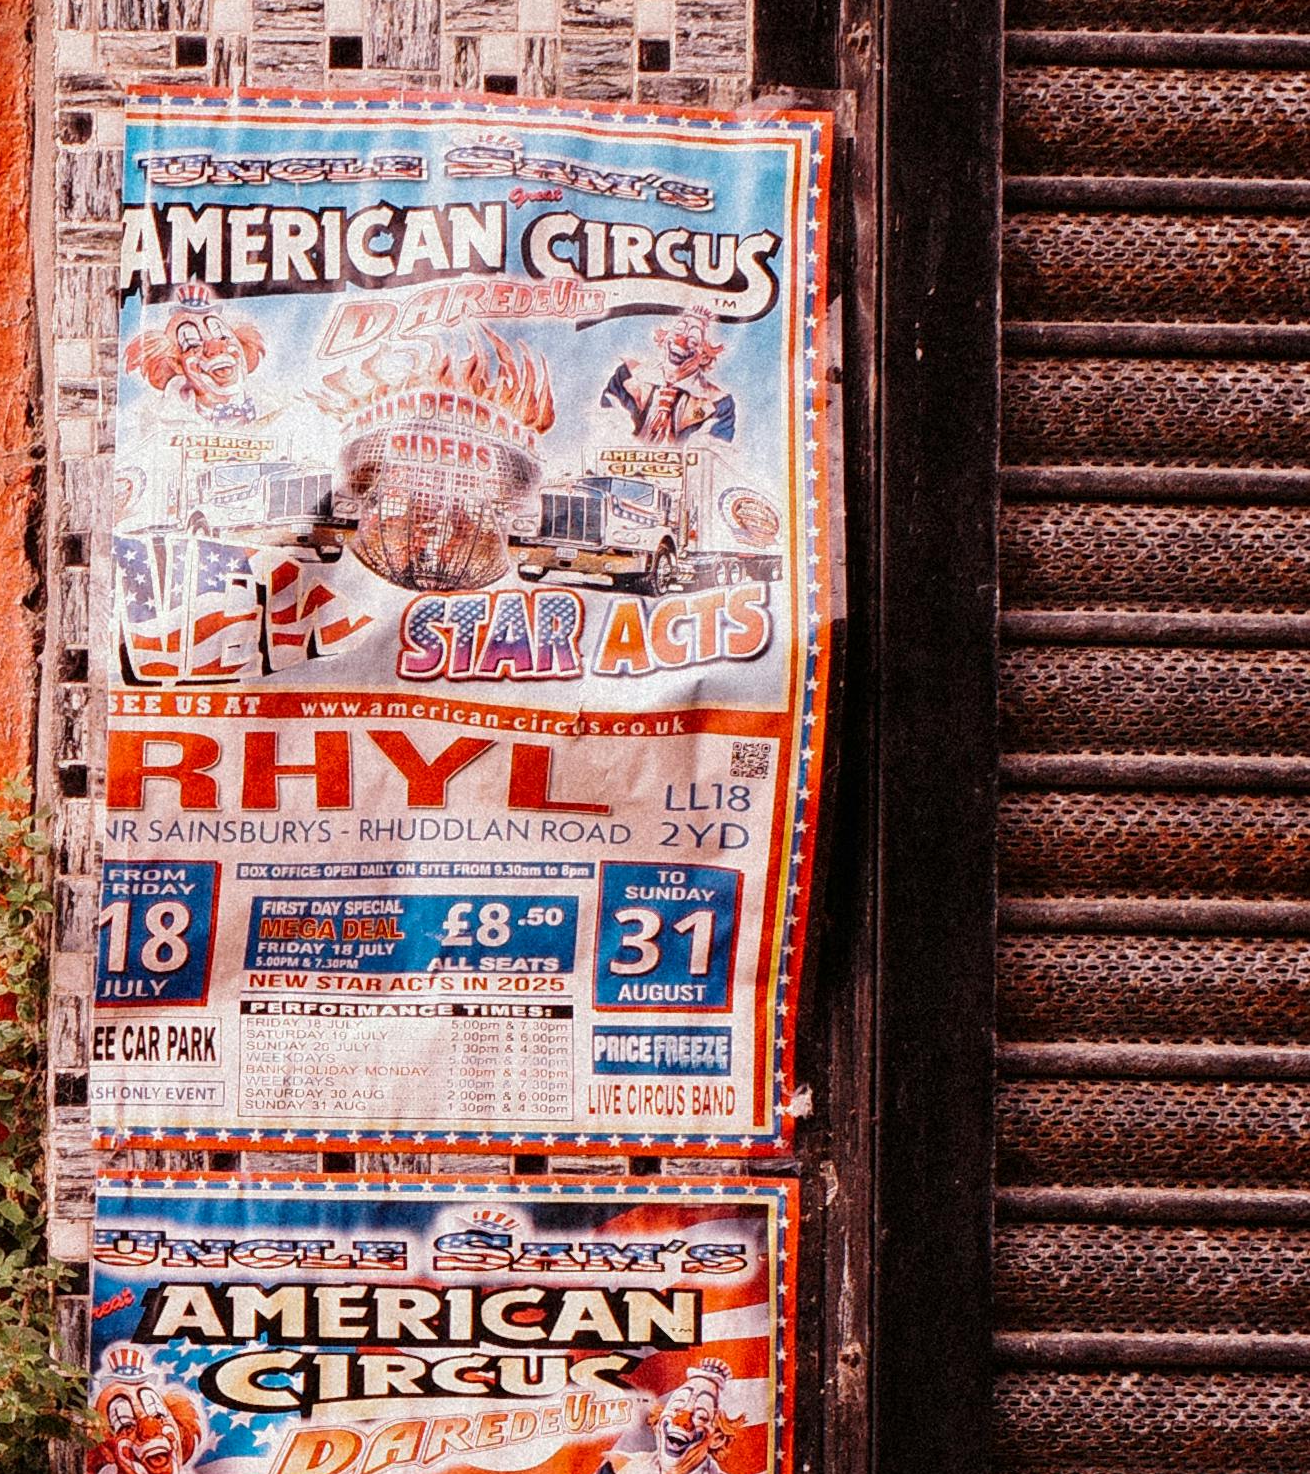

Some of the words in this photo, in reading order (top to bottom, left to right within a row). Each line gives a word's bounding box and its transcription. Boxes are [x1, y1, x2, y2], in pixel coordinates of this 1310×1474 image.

[137, 152, 428, 187] UNCLE
[444, 145, 715, 213] SAM'S
[119, 202, 505, 291] AMERICAN
[525, 211, 781, 322] CIRCUS
[397, 588, 584, 681] STAR
[592, 583, 773, 676] ACTS
[176, 696, 213, 715] US
[224, 696, 261, 715] AT
[301, 700, 686, 736] www.american-circus.co.uk
[106, 729, 613, 816] RHYL
[665, 782, 752, 813] LL18
[147, 819, 330, 844] SAINSBURYS
[360, 818, 530, 843] RHUDDLAN
[541, 819, 632, 845] ROAD
[659, 820, 750, 850] 2YD
[108, 868, 186, 882] FROM
[239, 865, 266, 878] BOX
[324, 865, 357, 878] OPEN
[360, 864, 393, 877] DAILY
[396, 863, 416, 876] ON
[419, 863, 450, 876] SITE
[453, 863, 491, 876] FROM
[545, 863, 557, 877] to
[656, 870, 685, 885] TO
[103, 882, 196, 896] FRIDAY
[625, 885, 715, 902] SUNDAY
[99, 900, 191, 974] 18
[259, 917, 335, 940] MEGA
[342, 917, 405, 940] DEAL
[440, 902, 511, 948] £8
[609, 906, 716, 977] 31
[427, 956, 474, 972] ALL
[478, 957, 559, 972] SEATS
[99, 978, 169, 998] JULY
[617, 983, 707, 1003] AUGUST
[122, 1025, 160, 1062] CAR
[167, 1025, 217, 1063] PARK
[588, 1084, 621, 1116] LIVE
[628, 1085, 685, 1116] CIRCUS
[691, 1085, 737, 1117] BAND
[94, 1229, 408, 1270] UNCLE
[433, 1228, 748, 1273] SAM'S
[146, 1283, 699, 1346] AMERICAN
[209, 1349, 634, 1410] CIRCUS
